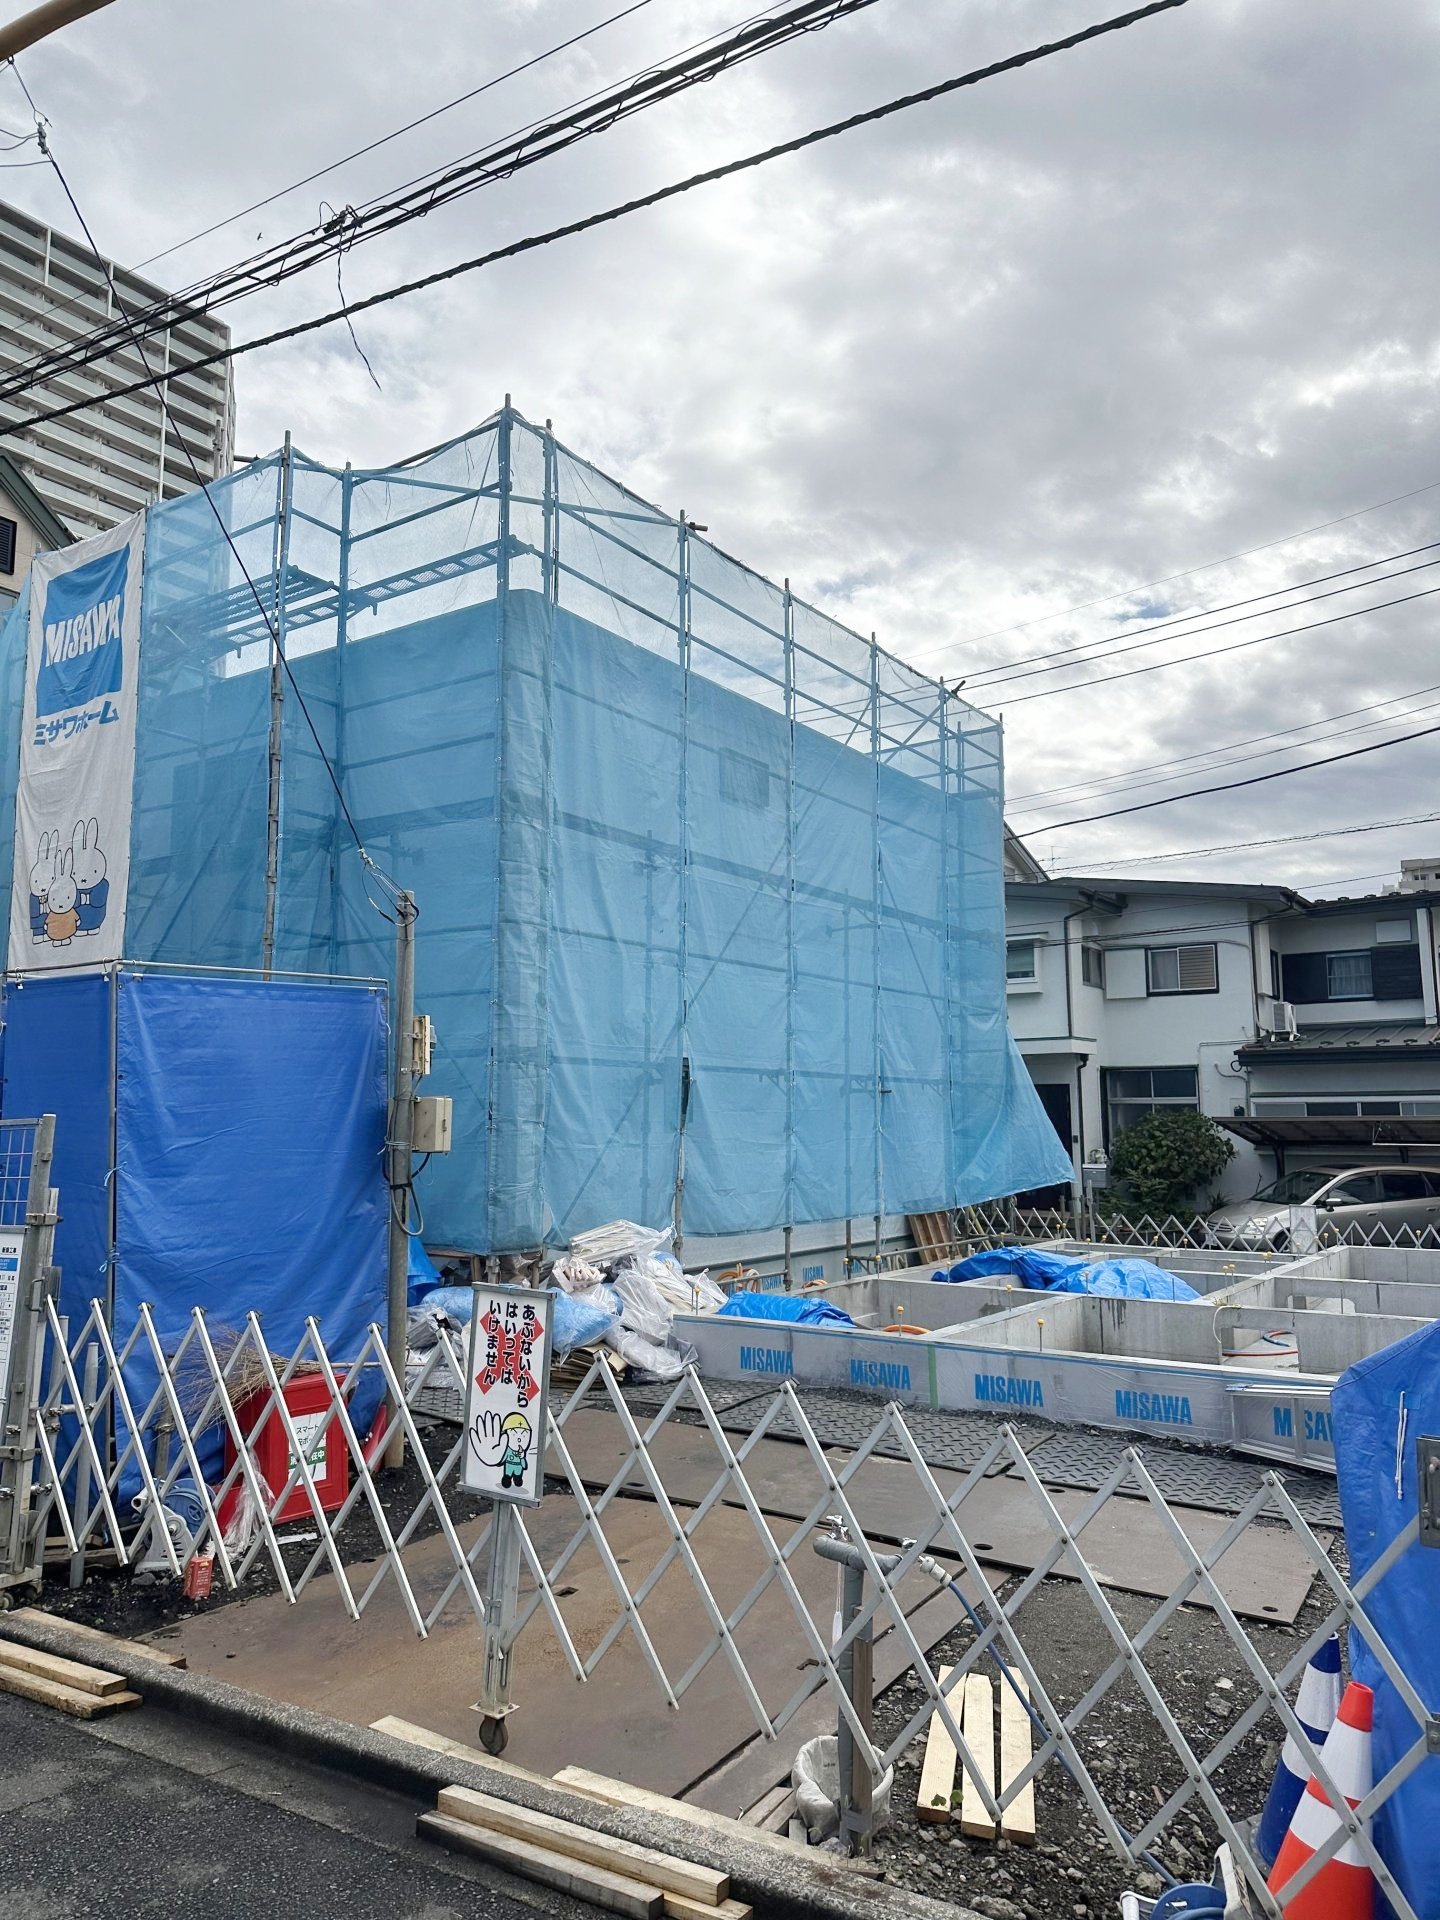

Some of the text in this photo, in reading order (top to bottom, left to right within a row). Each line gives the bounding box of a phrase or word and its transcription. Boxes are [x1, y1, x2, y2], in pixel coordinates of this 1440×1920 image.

[45, 594, 121, 668] MISAWA
[33, 701, 120, 746] ミサワホーム
[483, 1300, 501, 1385] いけません
[500, 1301, 518, 1385] はいっては
[516, 1304, 535, 1408] あぶないから
[740, 1346, 793, 1375] MISAWA
[850, 1359, 911, 1390] MISAWA
[974, 1373, 1044, 1408] MISAWA
[1115, 1389, 1192, 1425] MISAWA
